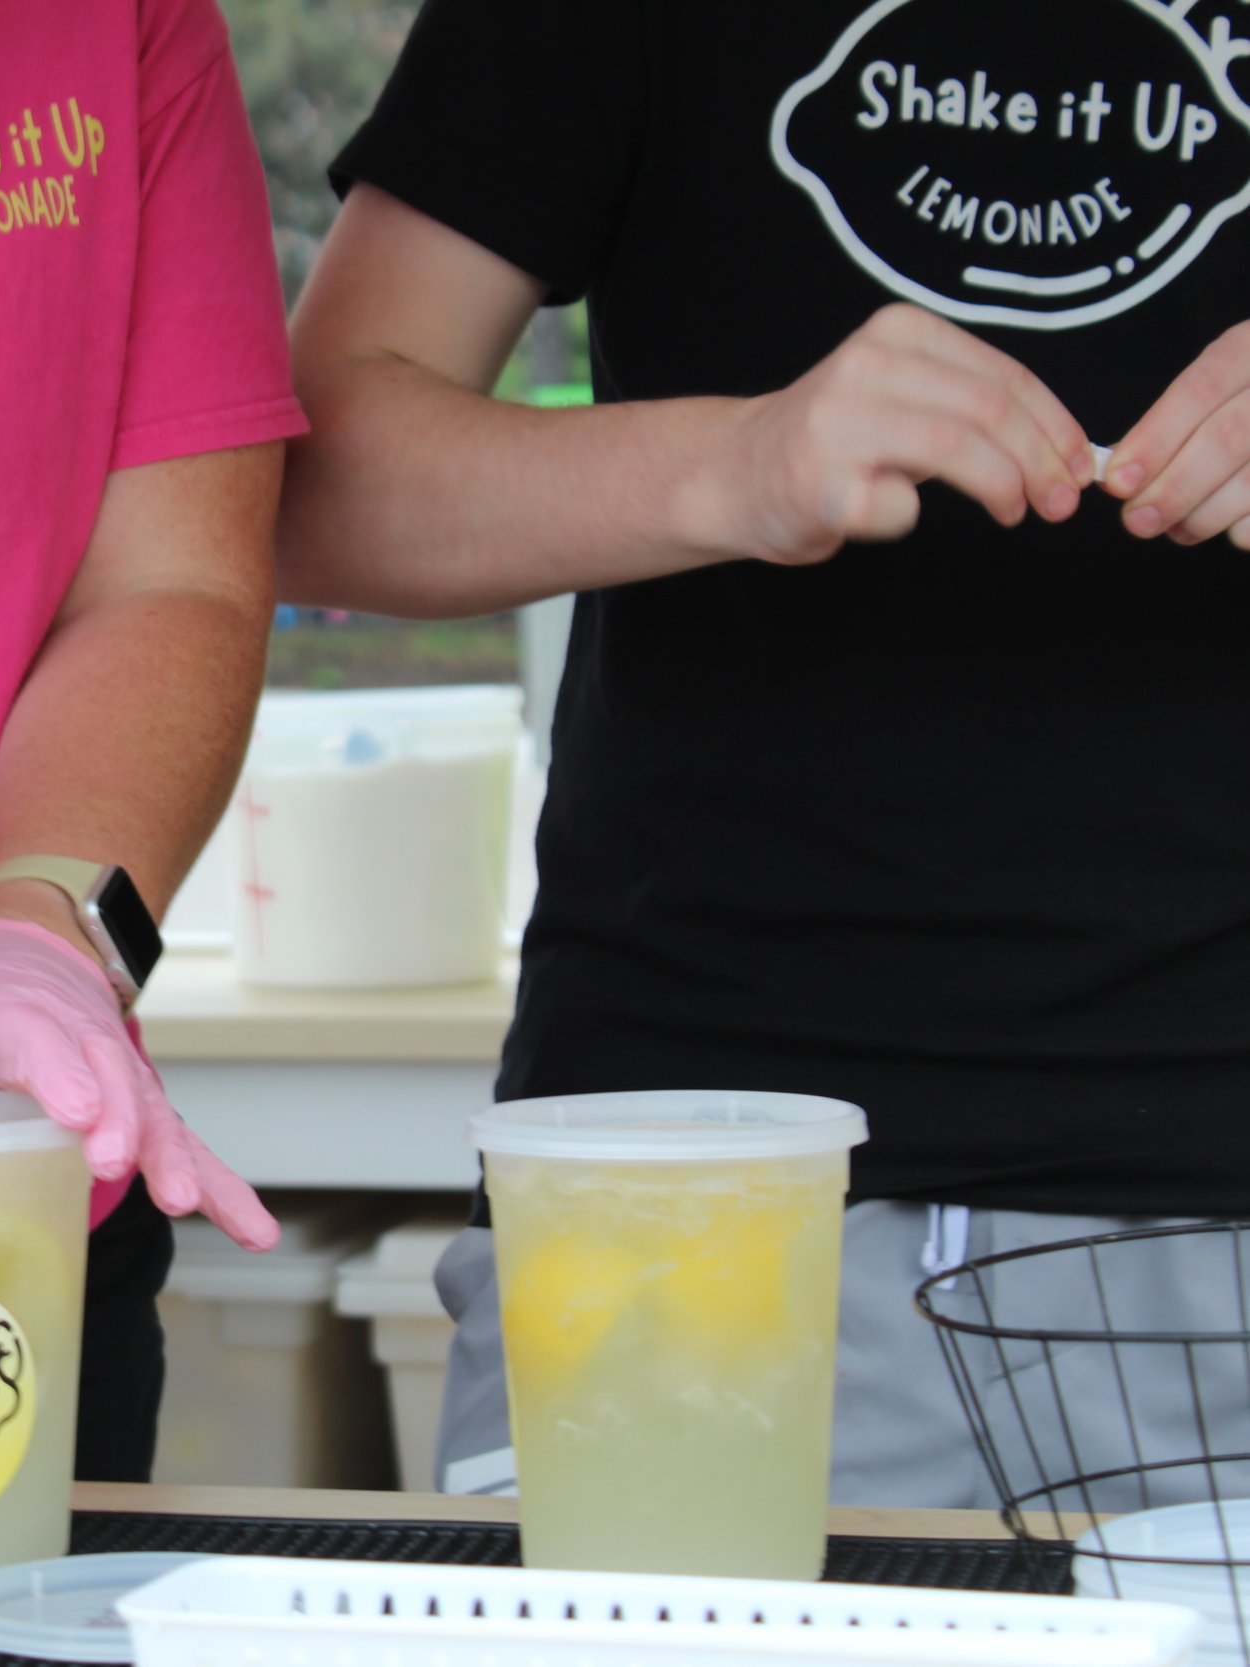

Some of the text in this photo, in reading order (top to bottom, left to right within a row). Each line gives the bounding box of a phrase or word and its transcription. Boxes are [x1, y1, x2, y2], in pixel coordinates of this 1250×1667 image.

[8, 108, 42, 167] it
[51, 97, 105, 176] Up
[856, 60, 1217, 161] Shake it Up
[896, 164, 1132, 246] LEMONADE
